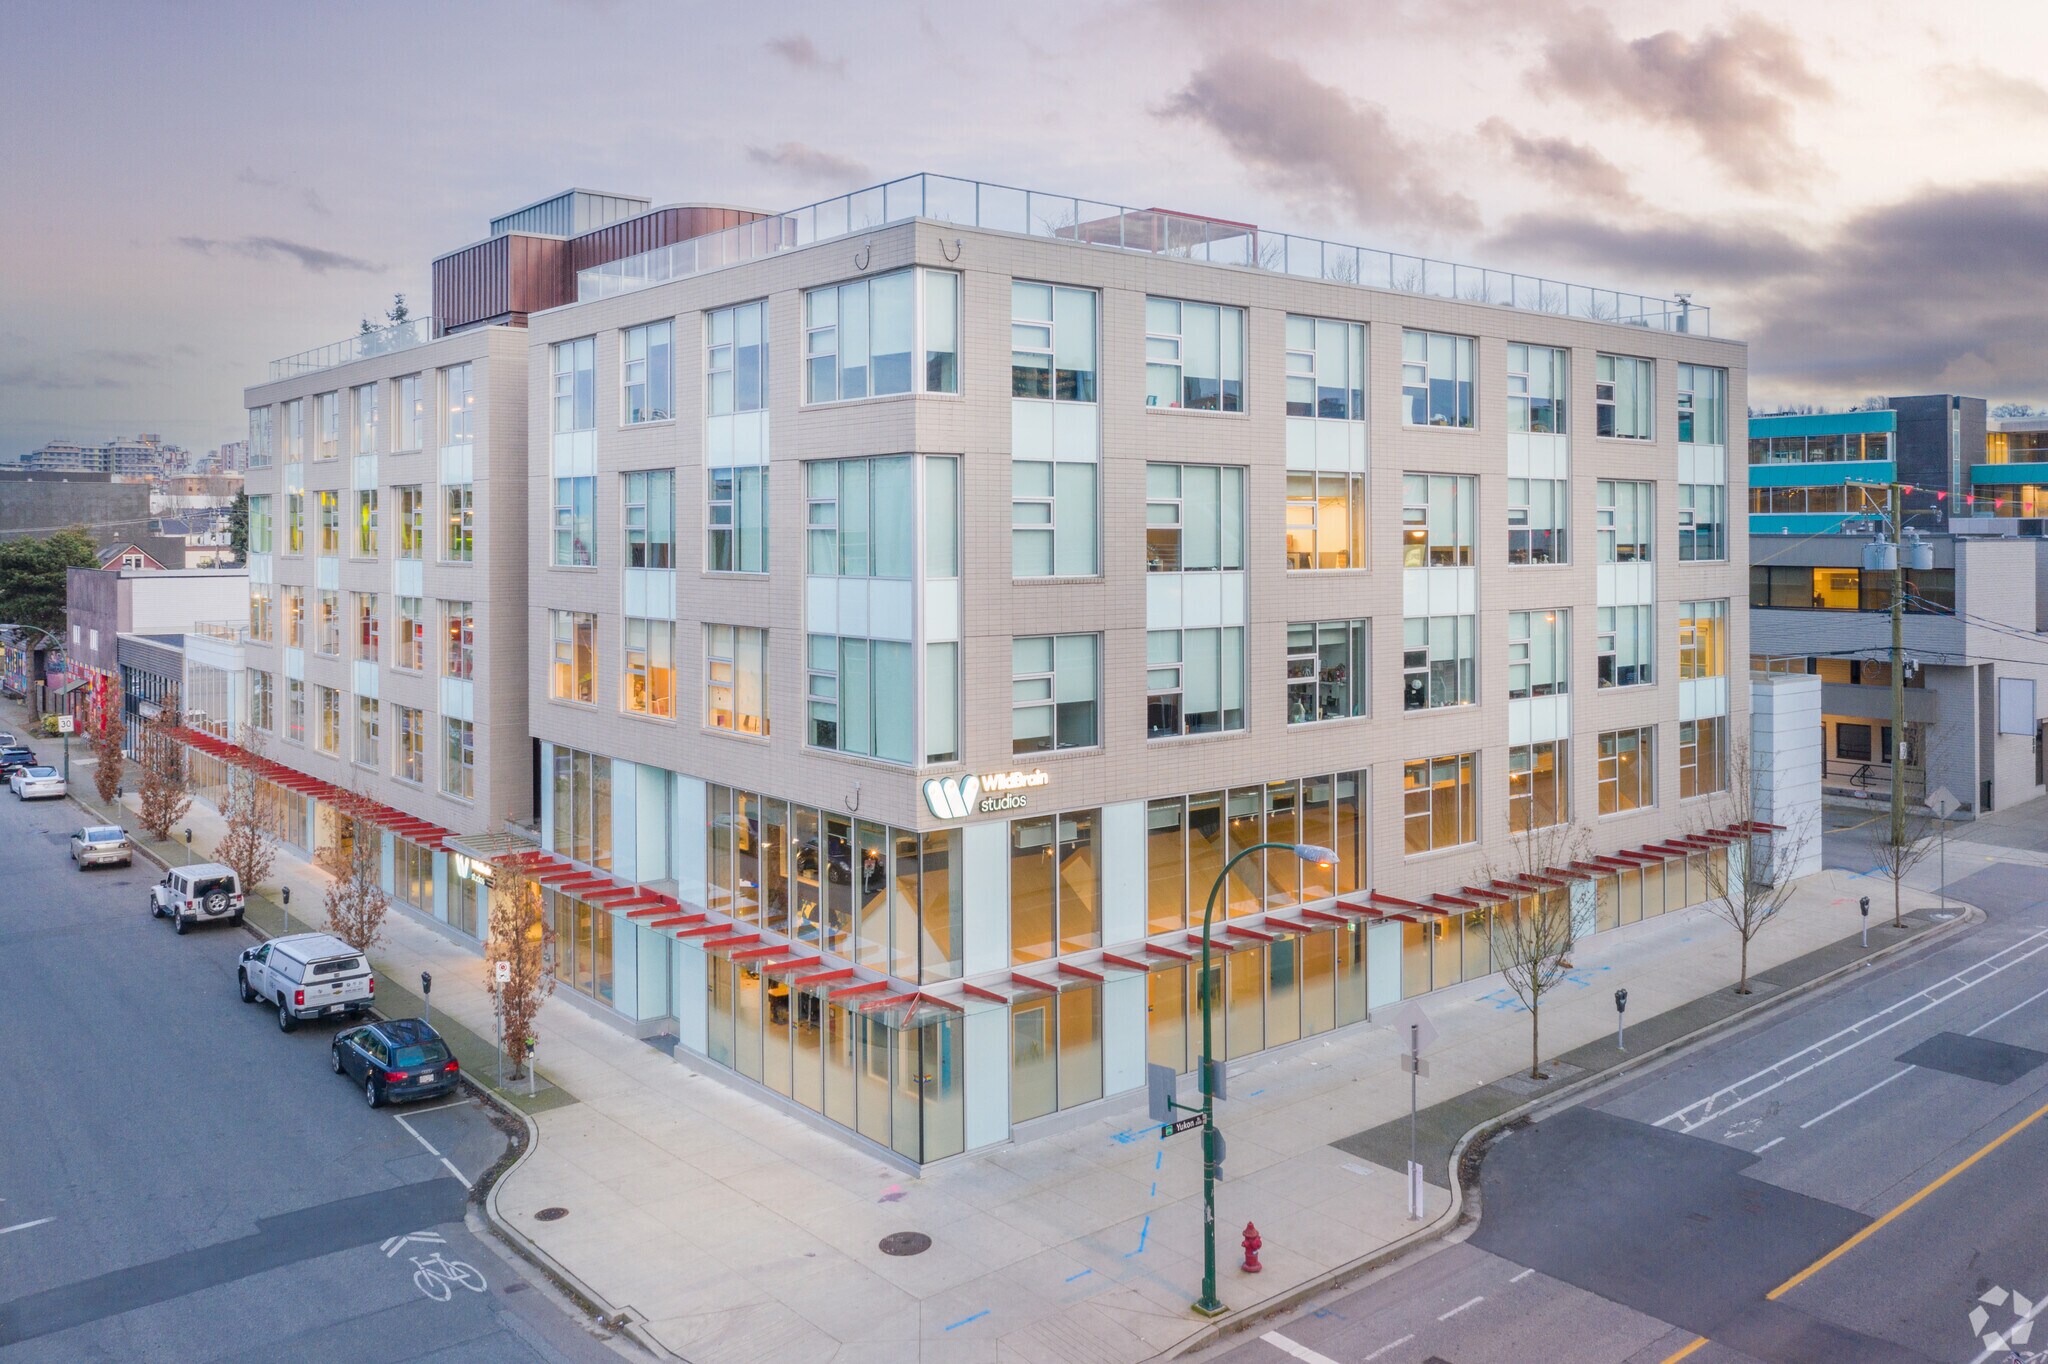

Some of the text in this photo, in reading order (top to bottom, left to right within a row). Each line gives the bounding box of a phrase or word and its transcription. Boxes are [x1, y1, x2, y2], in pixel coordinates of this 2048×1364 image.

[61, 719, 71, 728] 30
[980, 768, 1049, 792] WildBrain
[980, 793, 1027, 812] studios
[1176, 1120, 1195, 1131] Yukon
